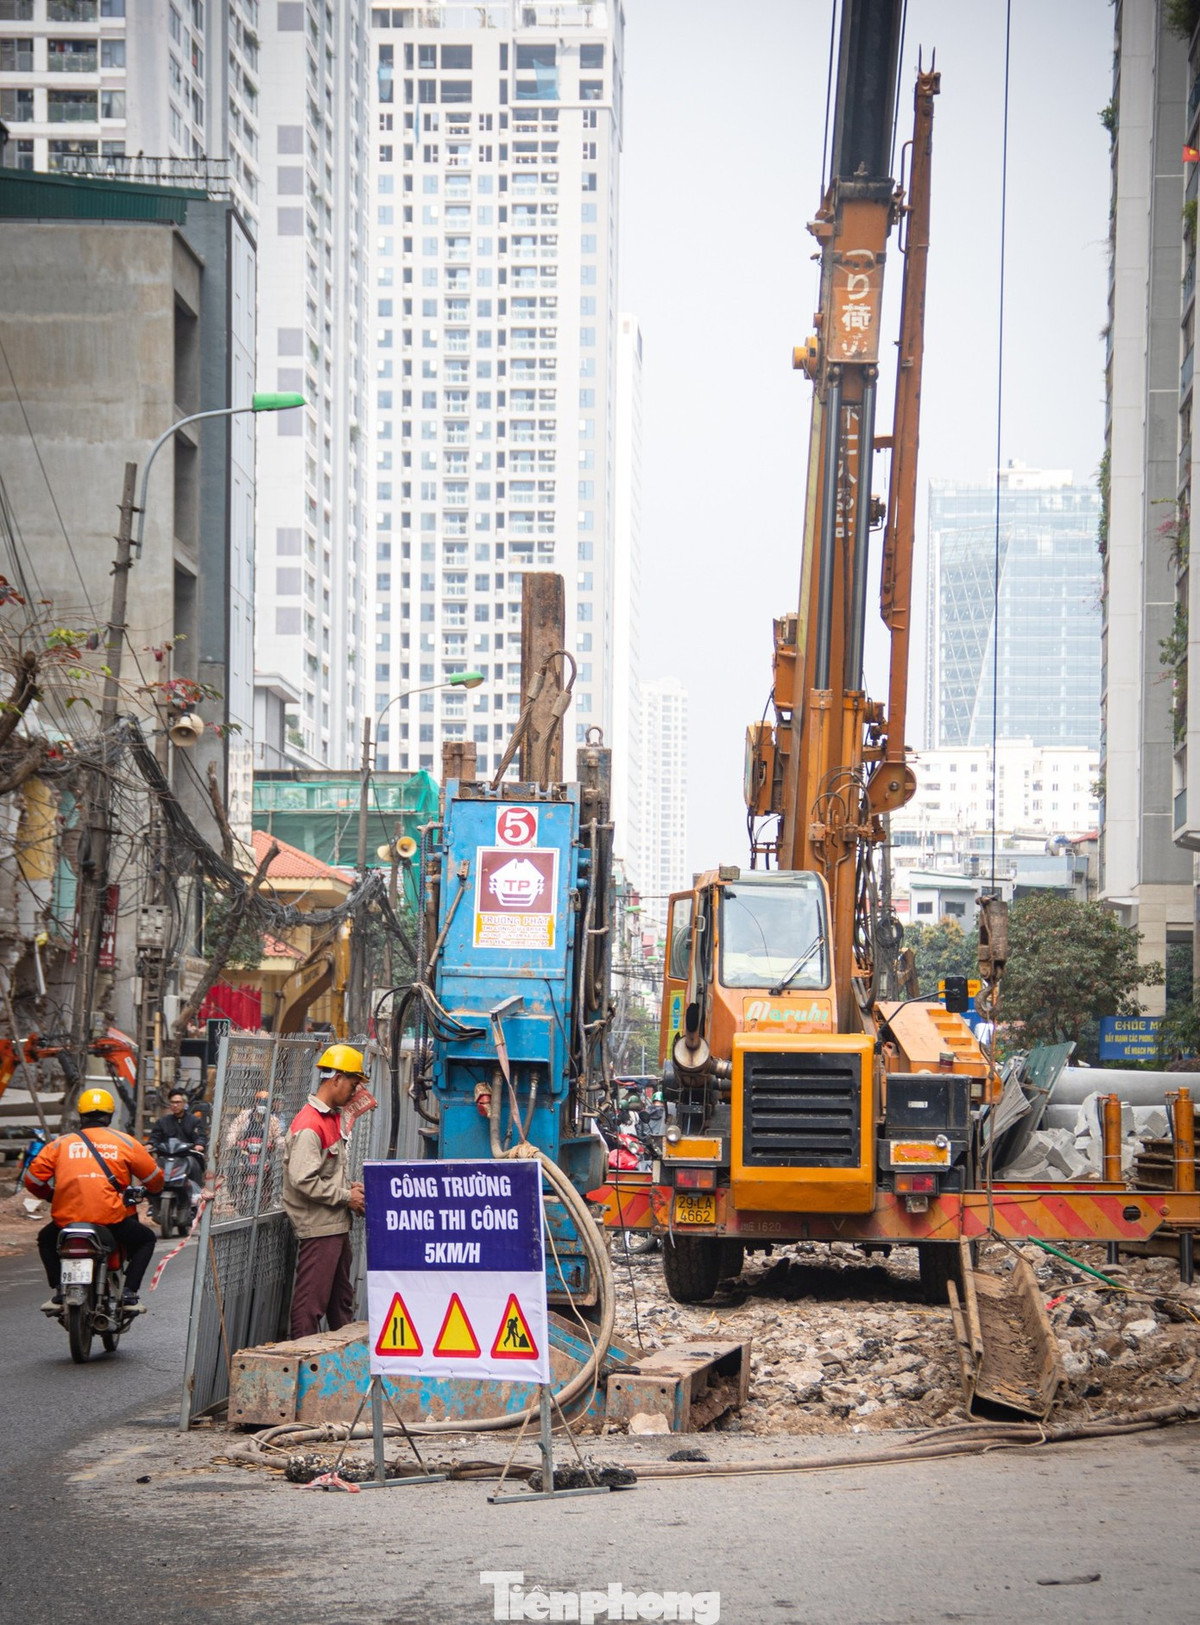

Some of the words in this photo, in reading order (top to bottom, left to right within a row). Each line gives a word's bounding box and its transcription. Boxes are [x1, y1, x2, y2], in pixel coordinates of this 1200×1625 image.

[503, 811, 530, 843] 5
[504, 879, 531, 892] TP
[92, 1142, 118, 1150] hopee
[390, 1173, 438, 1198] CÔNG
[441, 1171, 512, 1198] TRƯỜNG
[386, 1209, 435, 1231] ĐANG
[439, 1209, 466, 1230] THI
[471, 1205, 519, 1230] CÔNG
[680, 1210, 711, 1223] 4662
[424, 1242, 481, 1264] 5KM/H
